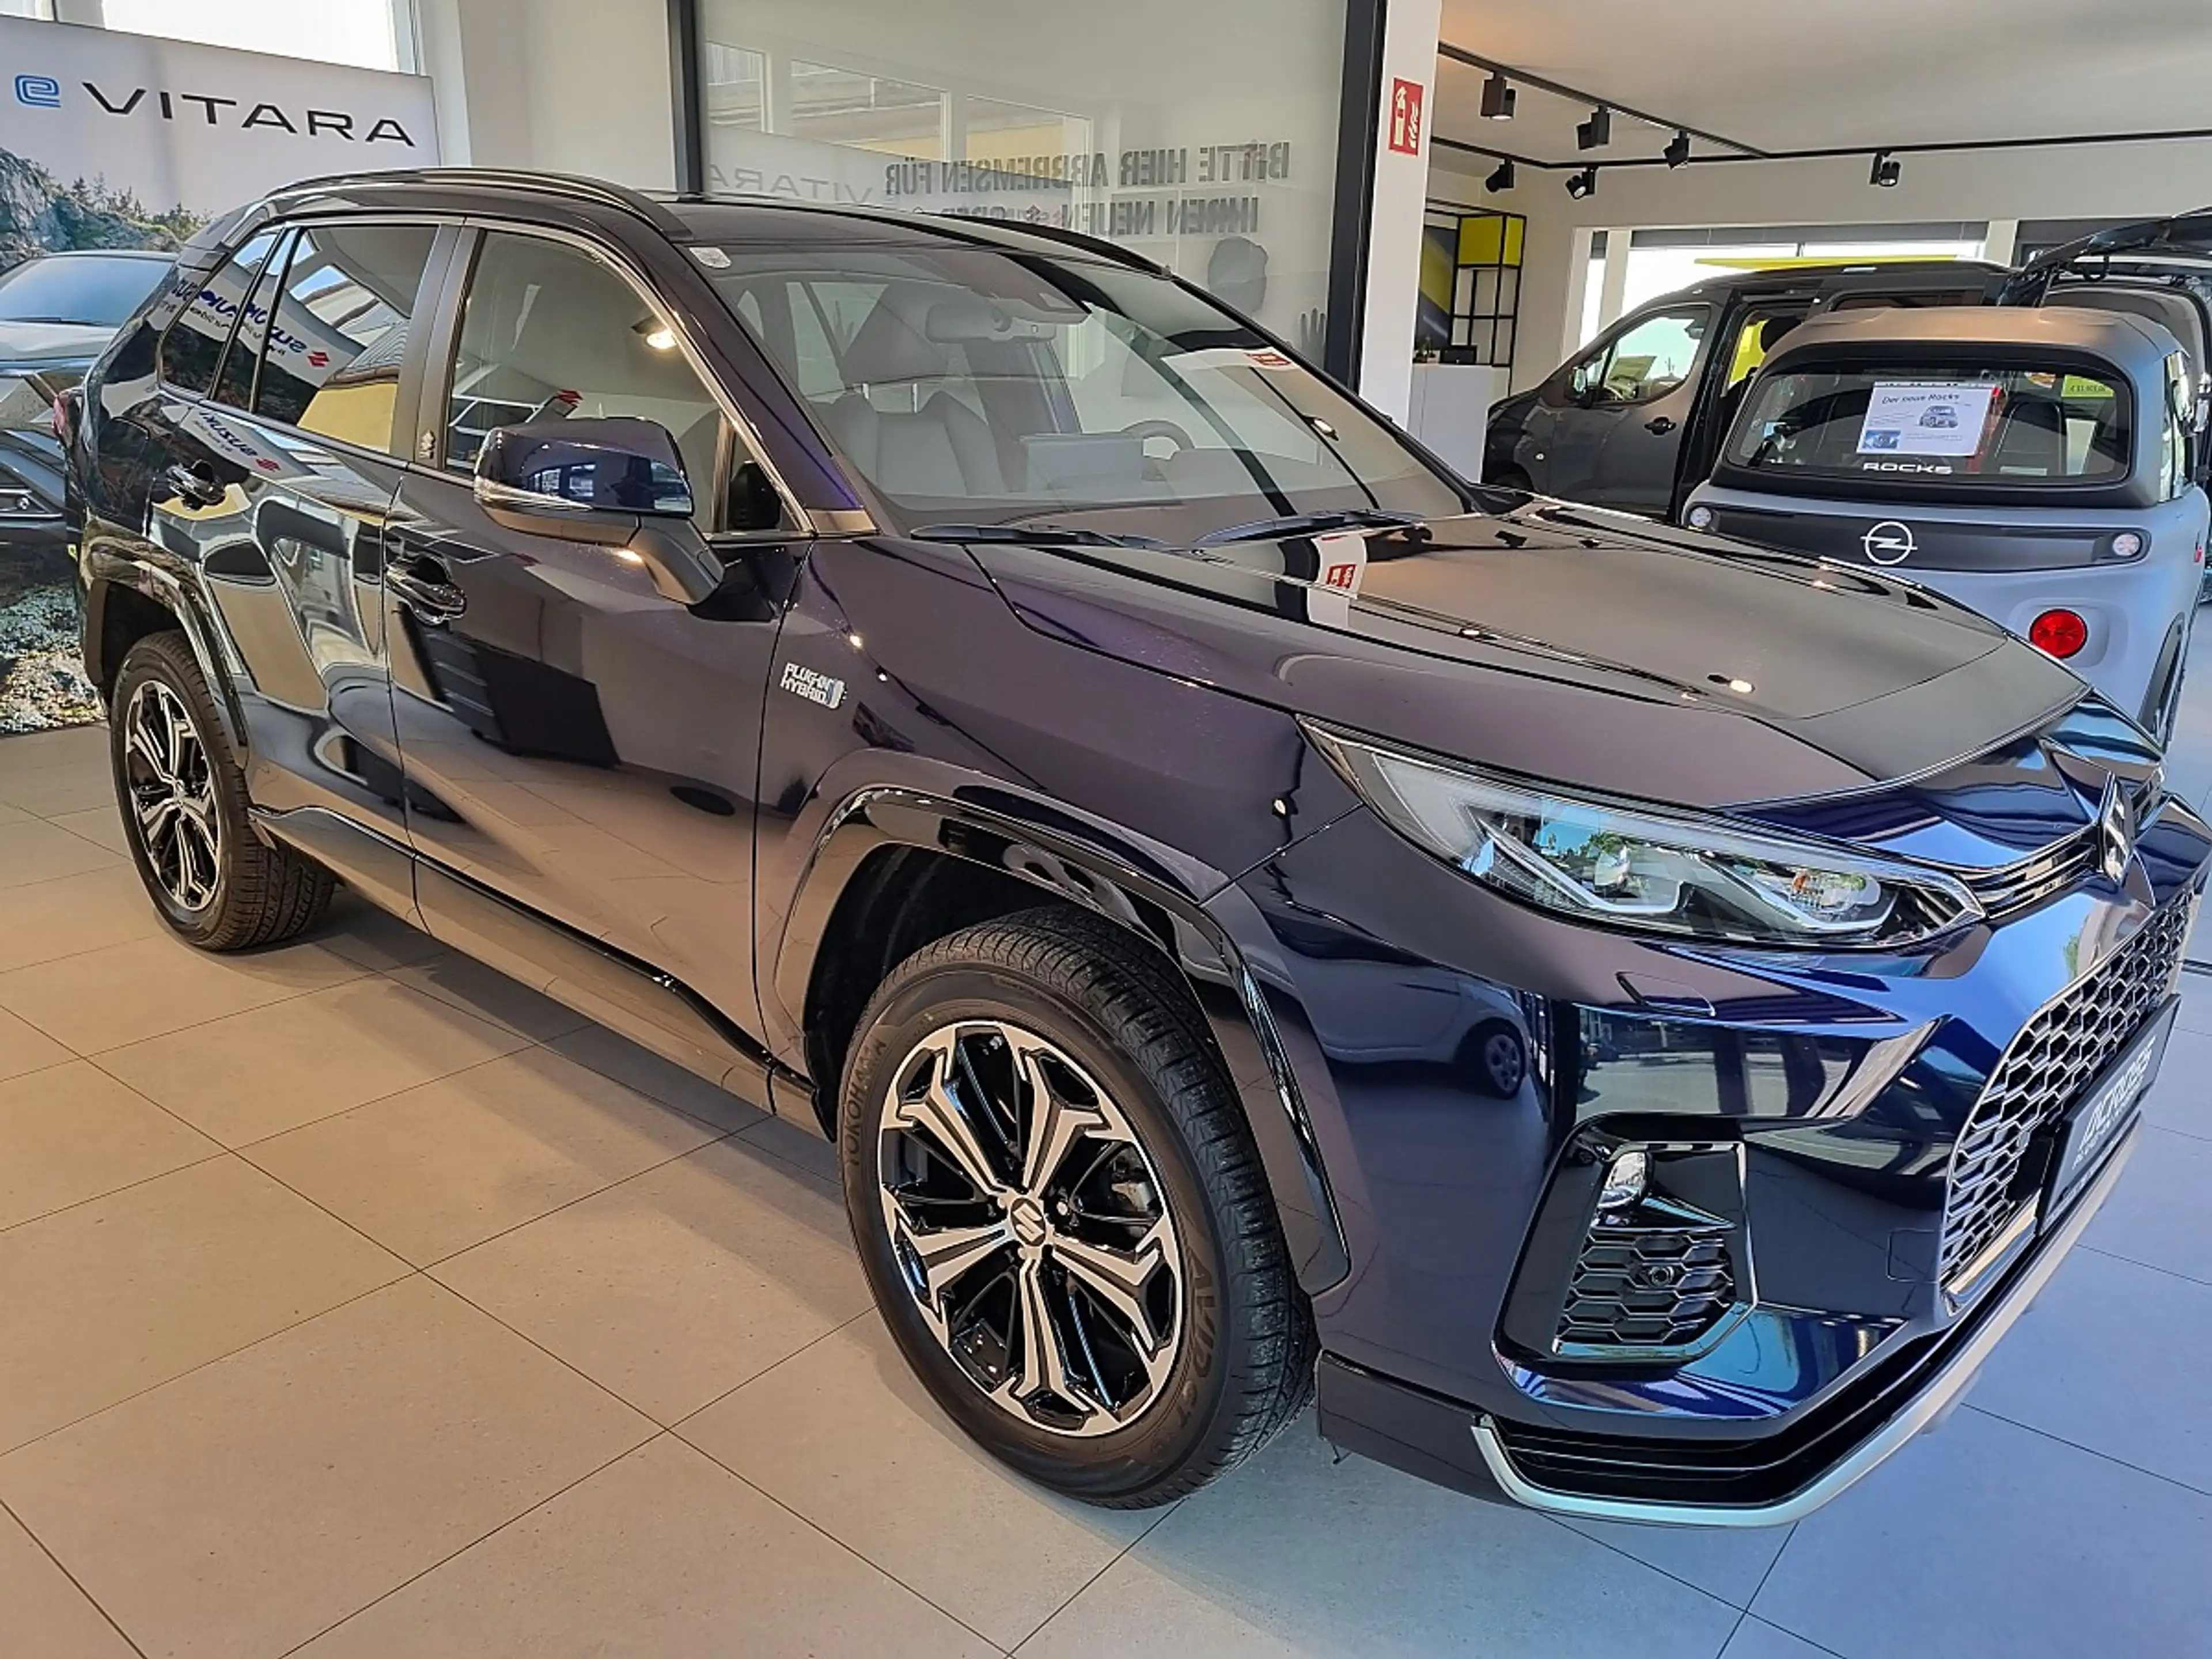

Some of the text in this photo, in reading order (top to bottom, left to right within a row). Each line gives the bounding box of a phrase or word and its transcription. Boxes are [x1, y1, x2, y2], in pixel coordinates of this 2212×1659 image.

[82, 82, 416, 147] VITARA
[1863, 462, 1953, 475] ROCKS
[780, 675, 827, 704] HYBRID
[844, 1037, 887, 1166] YOKOHAMA
[1188, 1248, 1217, 1377] AVID
